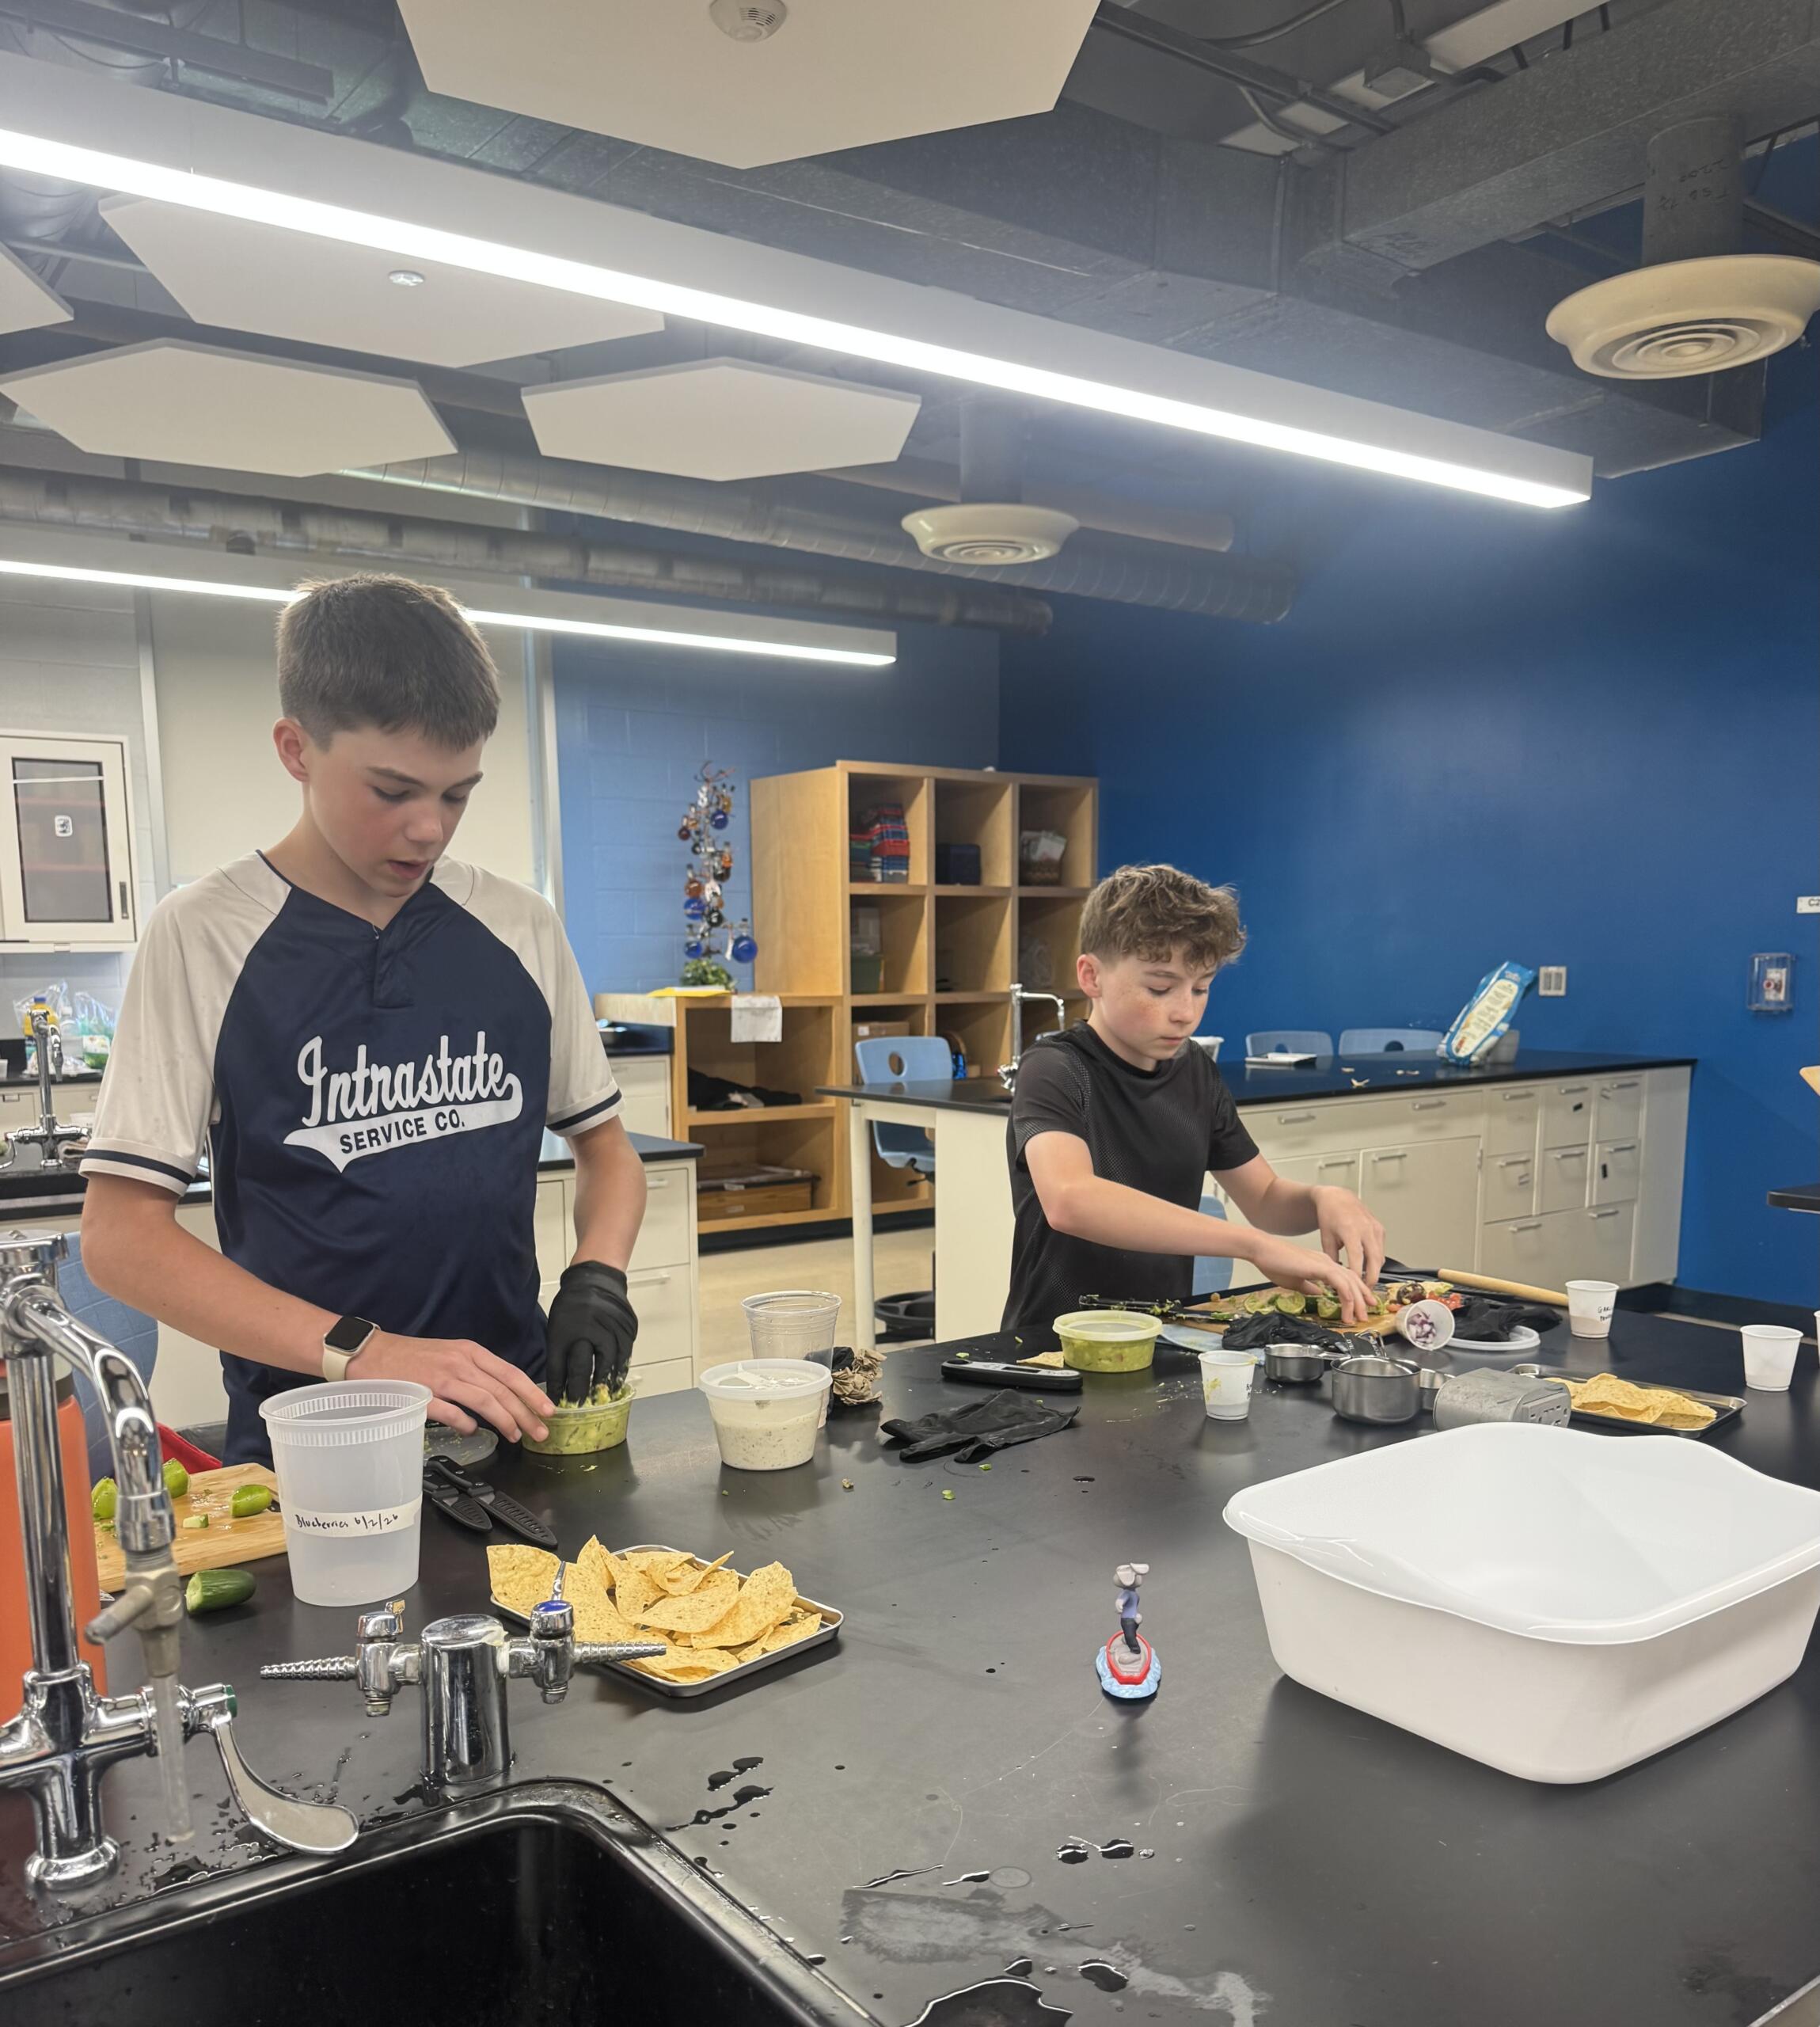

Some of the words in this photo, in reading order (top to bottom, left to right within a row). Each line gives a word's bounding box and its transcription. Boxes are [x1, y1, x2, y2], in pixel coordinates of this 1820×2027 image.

[297, 1030, 507, 1128] Intrastate
[340, 1116, 427, 1154] SERVICE
[435, 1109, 465, 1131] CO.
[294, 1514, 349, 1530] Blueberries
[354, 1513, 398, 1531] 6/2/26
